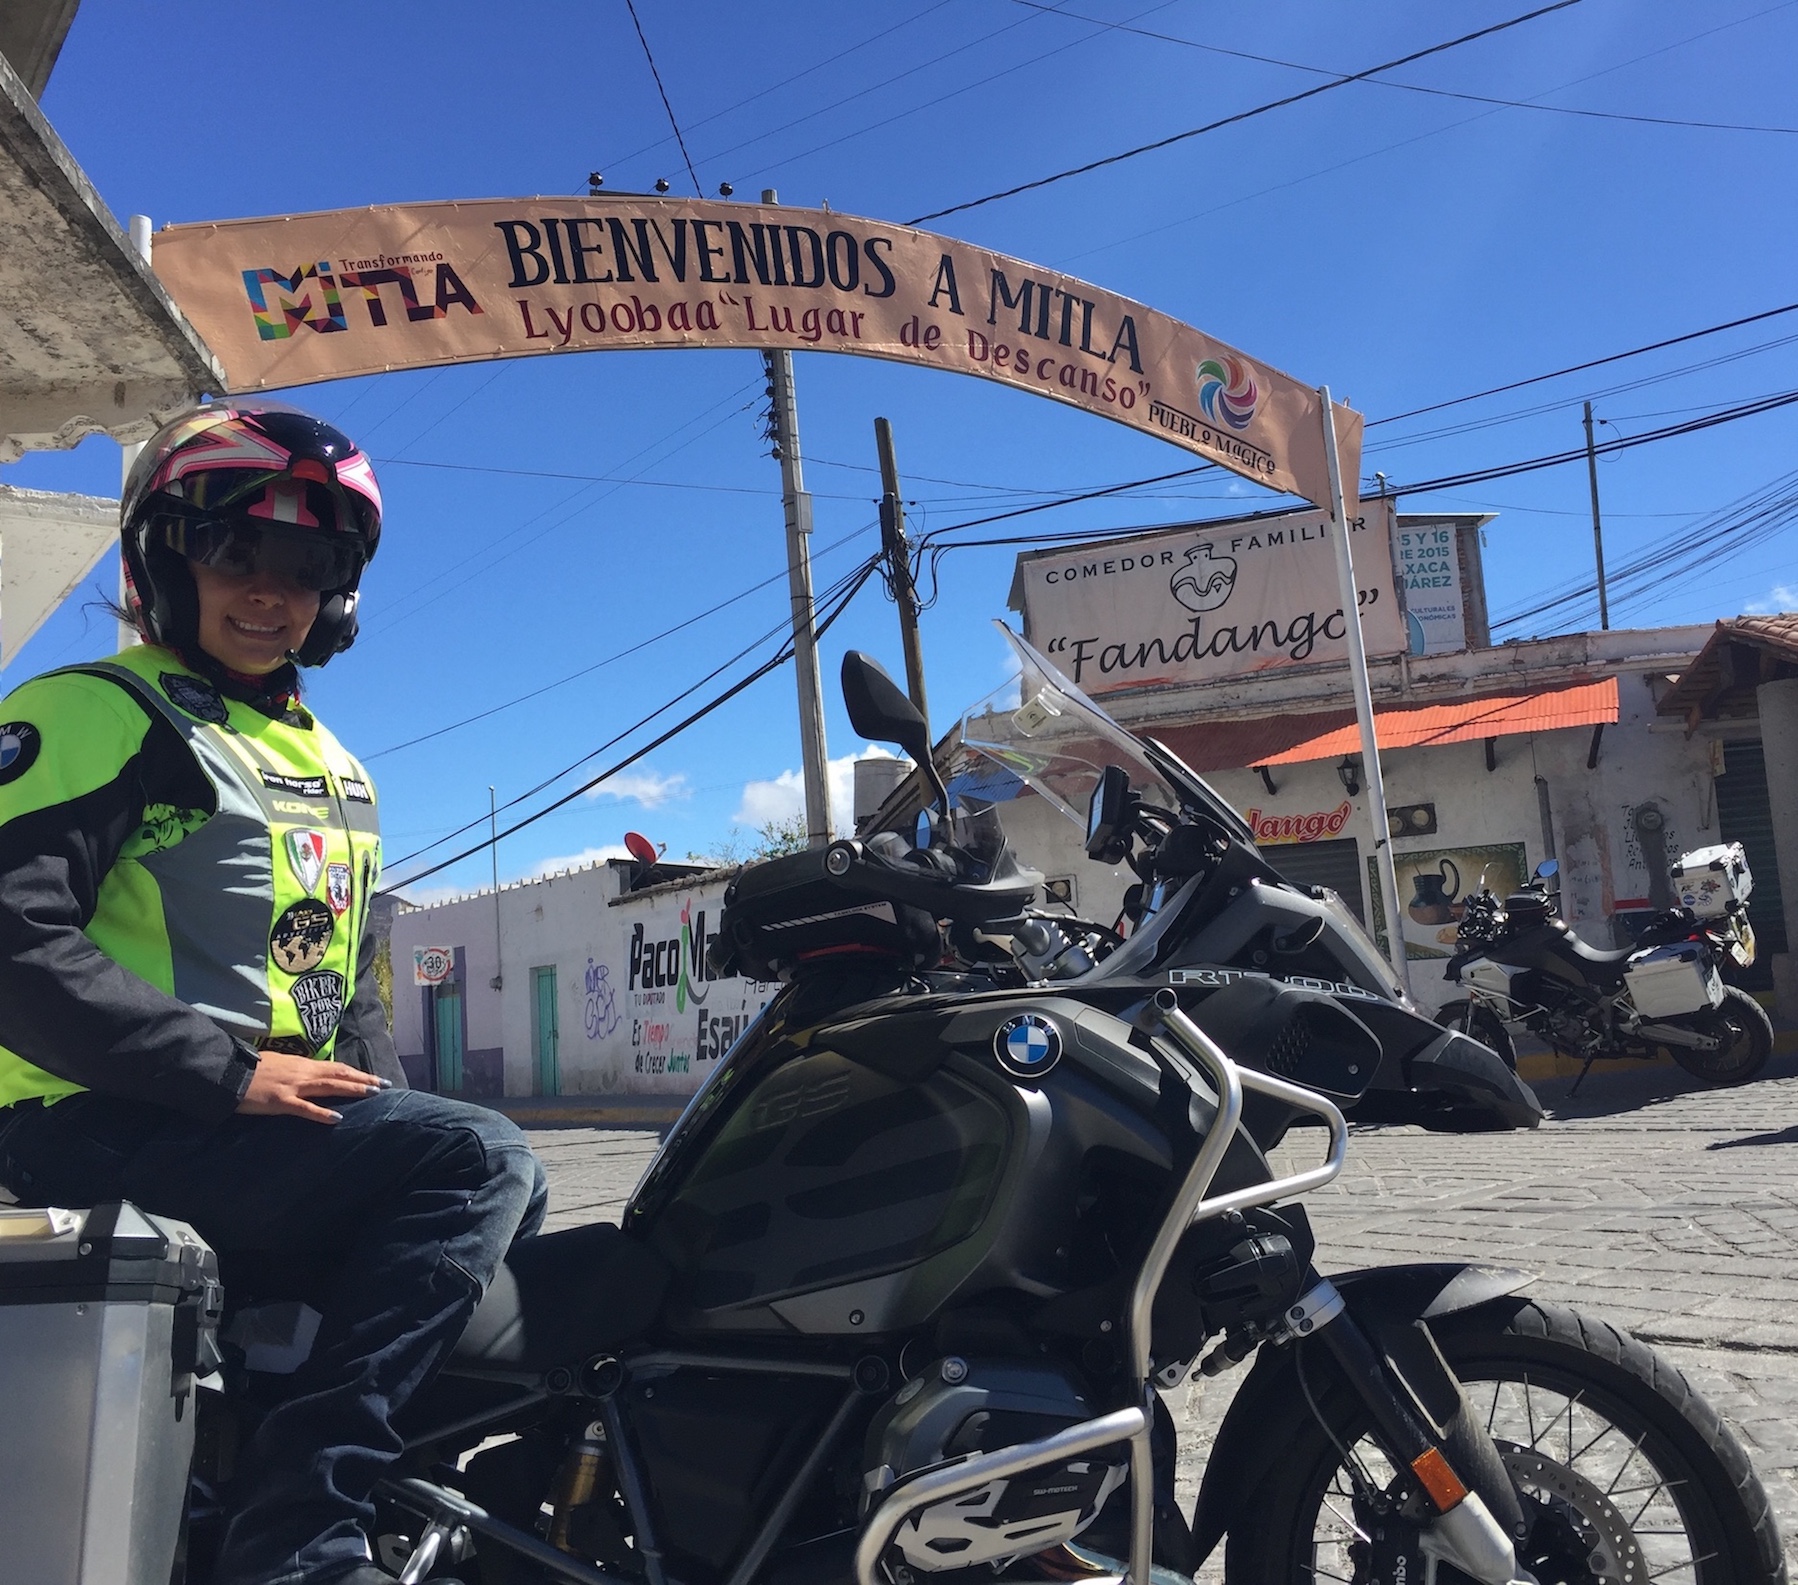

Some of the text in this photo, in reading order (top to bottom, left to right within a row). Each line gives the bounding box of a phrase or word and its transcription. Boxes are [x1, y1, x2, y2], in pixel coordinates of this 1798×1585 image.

[339, 252, 443, 272] Transformando
[494, 217, 1145, 376] BIENVENIDOS A MITLA
[516, 295, 721, 346] Lyoobaa
[900, 315, 942, 351] de
[1415, 532, 1427, 545] Y
[1431, 531, 1450, 544] 16
[1046, 517, 1367, 585] COMEDOR FAMILIR
[1417, 547, 1450, 559] 2015
[1403, 561, 1451, 575] XACA
[293, 912, 329, 931] GS
[629, 921, 680, 991] Paco
[295, 975, 339, 1005] BIKER
[1002, 1014, 1057, 1037] BMW
